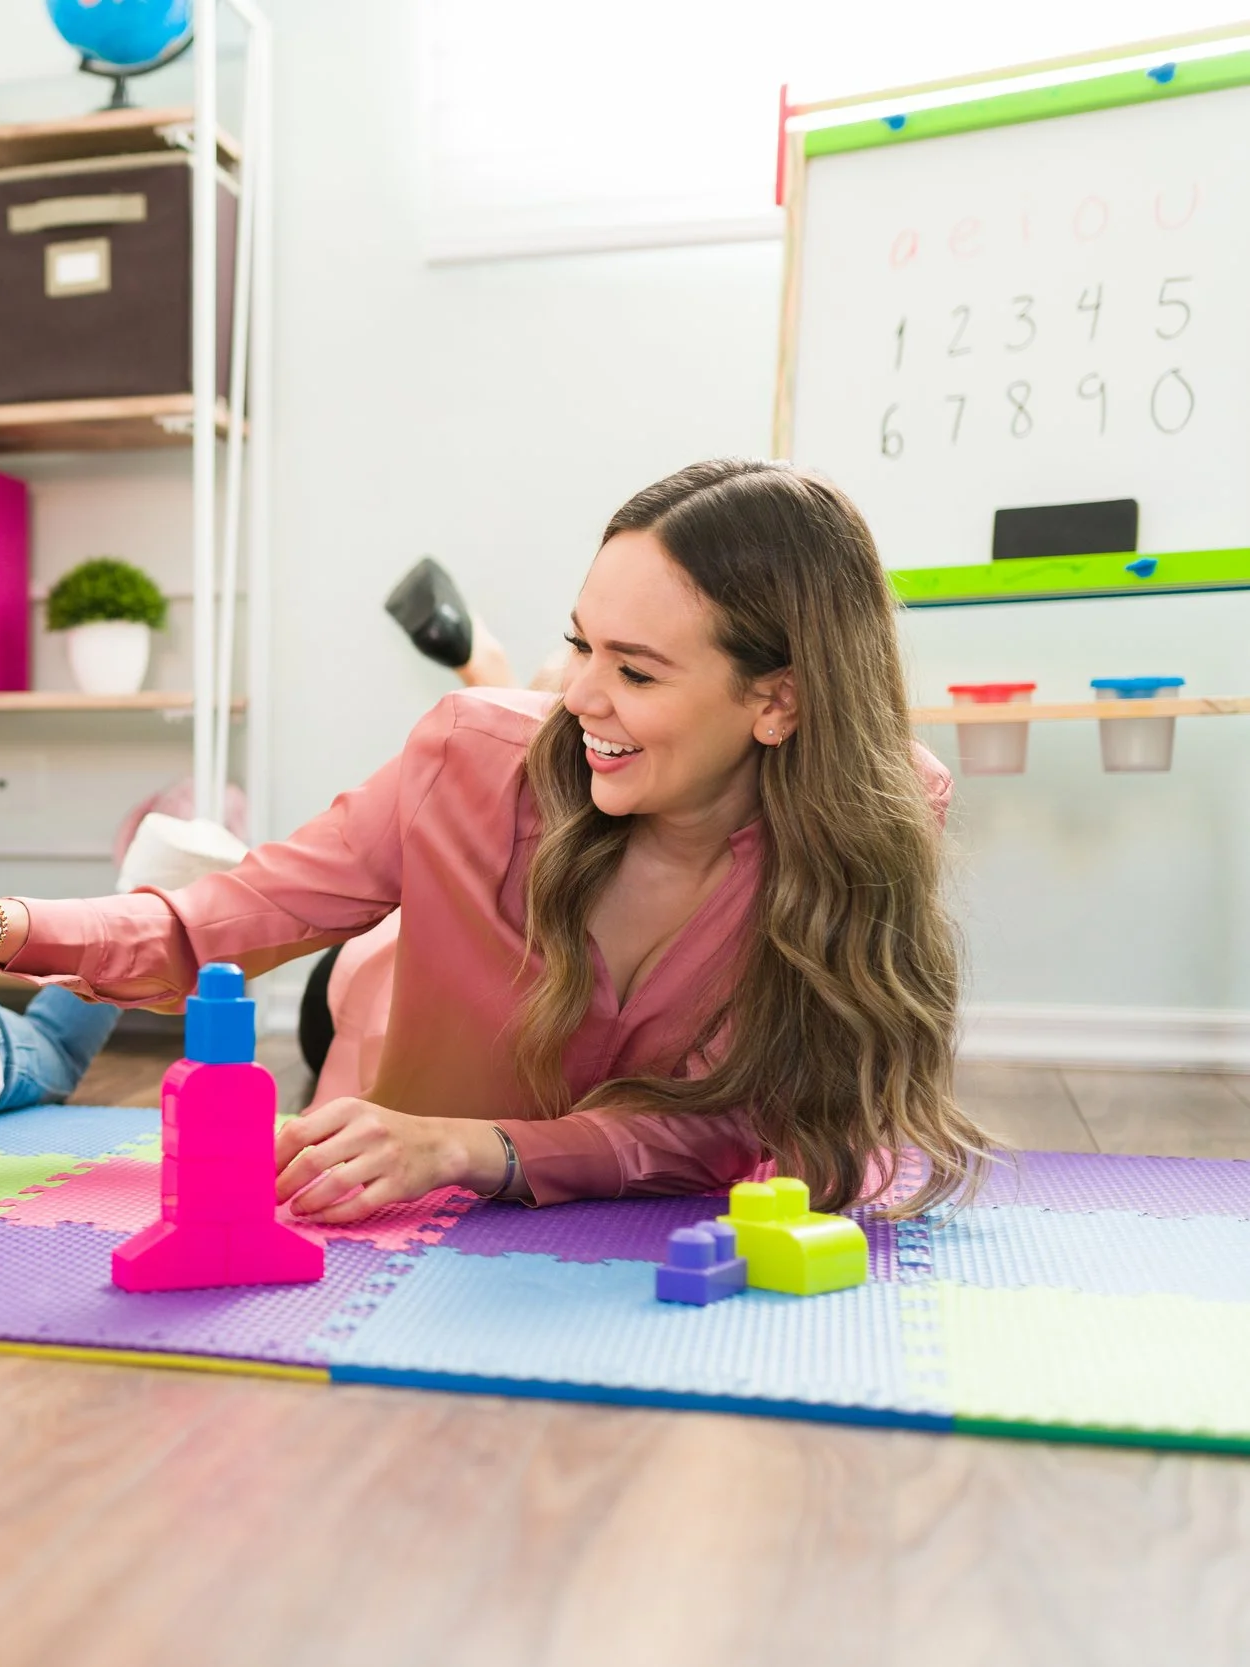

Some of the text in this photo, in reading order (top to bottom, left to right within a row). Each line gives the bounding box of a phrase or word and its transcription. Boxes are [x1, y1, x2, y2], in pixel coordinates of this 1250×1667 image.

[889, 227, 919, 269] a
[947, 216, 982, 260] e
[894, 275, 1193, 371] 1 2 3 4 5
[880, 368, 1196, 460] 6 7 8 9 0
